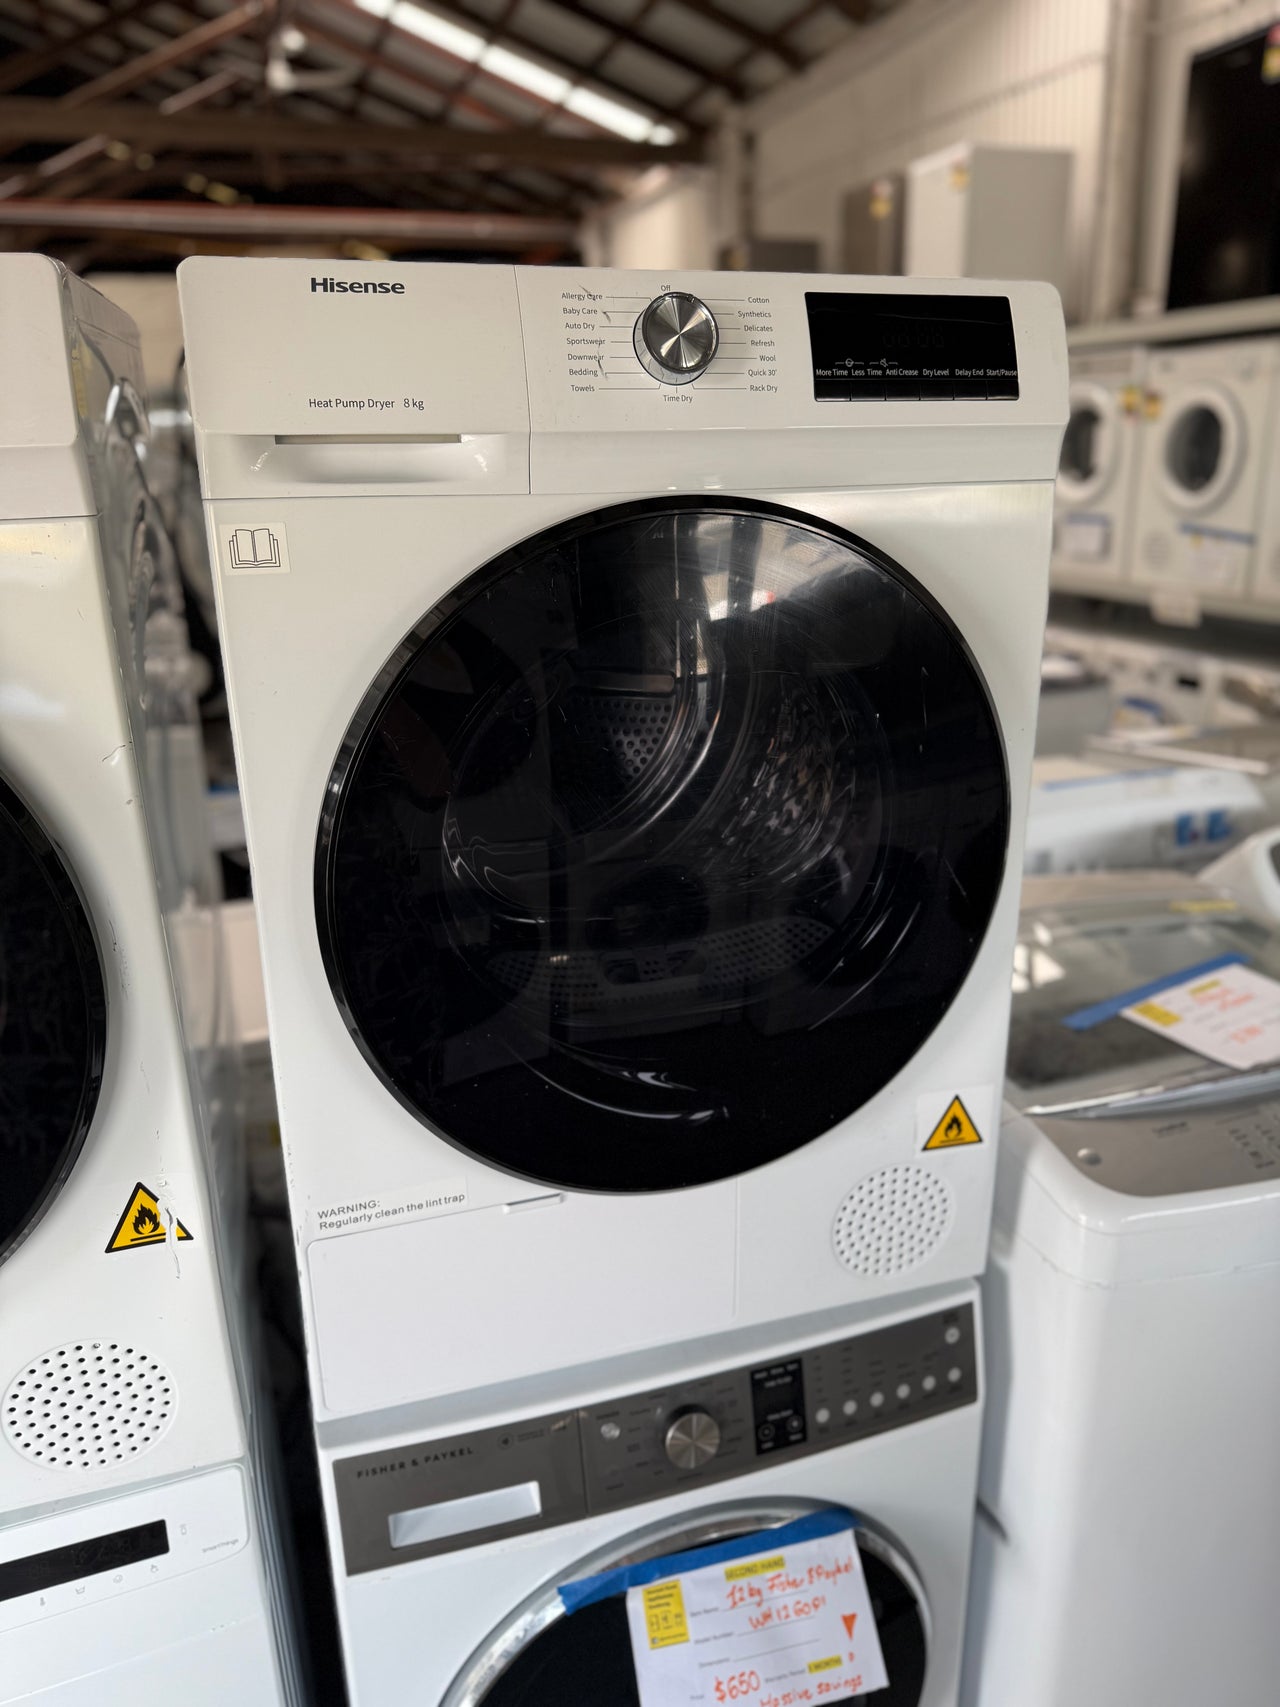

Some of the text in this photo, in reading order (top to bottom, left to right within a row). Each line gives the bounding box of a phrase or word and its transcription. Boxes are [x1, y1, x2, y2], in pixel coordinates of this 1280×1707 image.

[311, 277, 405, 295] Hisense
[660, 284, 671, 292] Off
[561, 292, 603, 301] Allergy Care
[747, 296, 770, 304] Cotton
[562, 307, 598, 316] Baby Care
[737, 310, 772, 319] Synthetics
[565, 322, 596, 331] Auto Dry
[743, 324, 774, 332] Delicates
[566, 337, 606, 347] Sportswear
[750, 339, 775, 347] Refresh
[567, 353, 605, 362] Downwear
[759, 354, 777, 362] Wool
[568, 368, 599, 378] Bedding
[747, 368, 767, 378] Quick
[815, 368, 849, 377] More Time
[851, 368, 883, 377] Less Time
[885, 368, 919, 377] Anti Crease
[922, 368, 950, 378] Dry Level
[954, 368, 985, 378] Delay End
[986, 368, 1018, 377] Start/Pause
[570, 384, 596, 392] Towels
[749, 384, 778, 393] Rack Dry
[663, 394, 693, 403] Time Dry
[308, 398, 425, 411] Heat Pump Dryer 8 kg
[317, 1199, 381, 1220] WARNING:
[319, 1193, 466, 1231] Regularly clean the lint trap
[357, 1447, 474, 1479] FISHER & PAYKEL
[713, 1669, 761, 1703] $650
